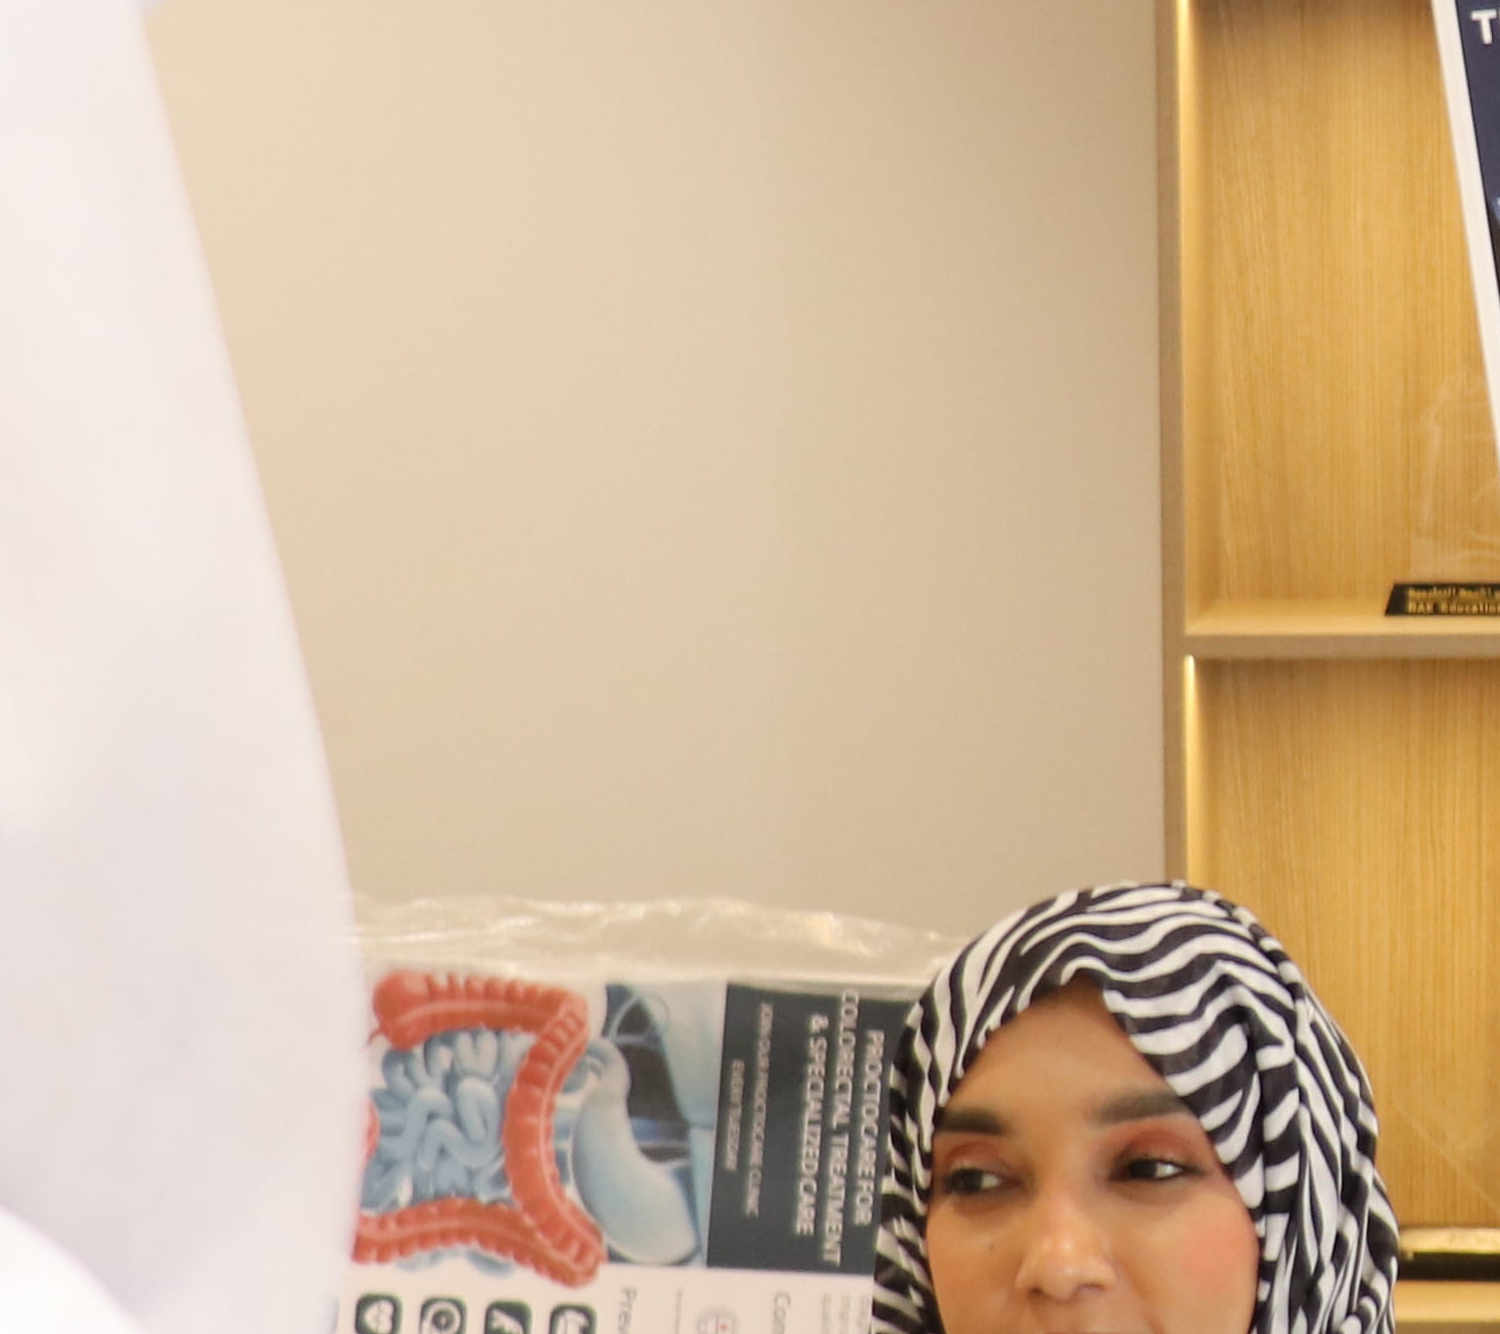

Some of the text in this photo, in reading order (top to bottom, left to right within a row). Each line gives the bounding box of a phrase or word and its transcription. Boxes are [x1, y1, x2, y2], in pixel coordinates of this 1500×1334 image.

[797, 1014, 827, 1234] & SPECIALIZED CARE
[833, 989, 858, 1129] COLORECTAL
[854, 1030, 883, 1225] PROCTOCARE FOR
[823, 1133, 848, 1265] TREATMENT
